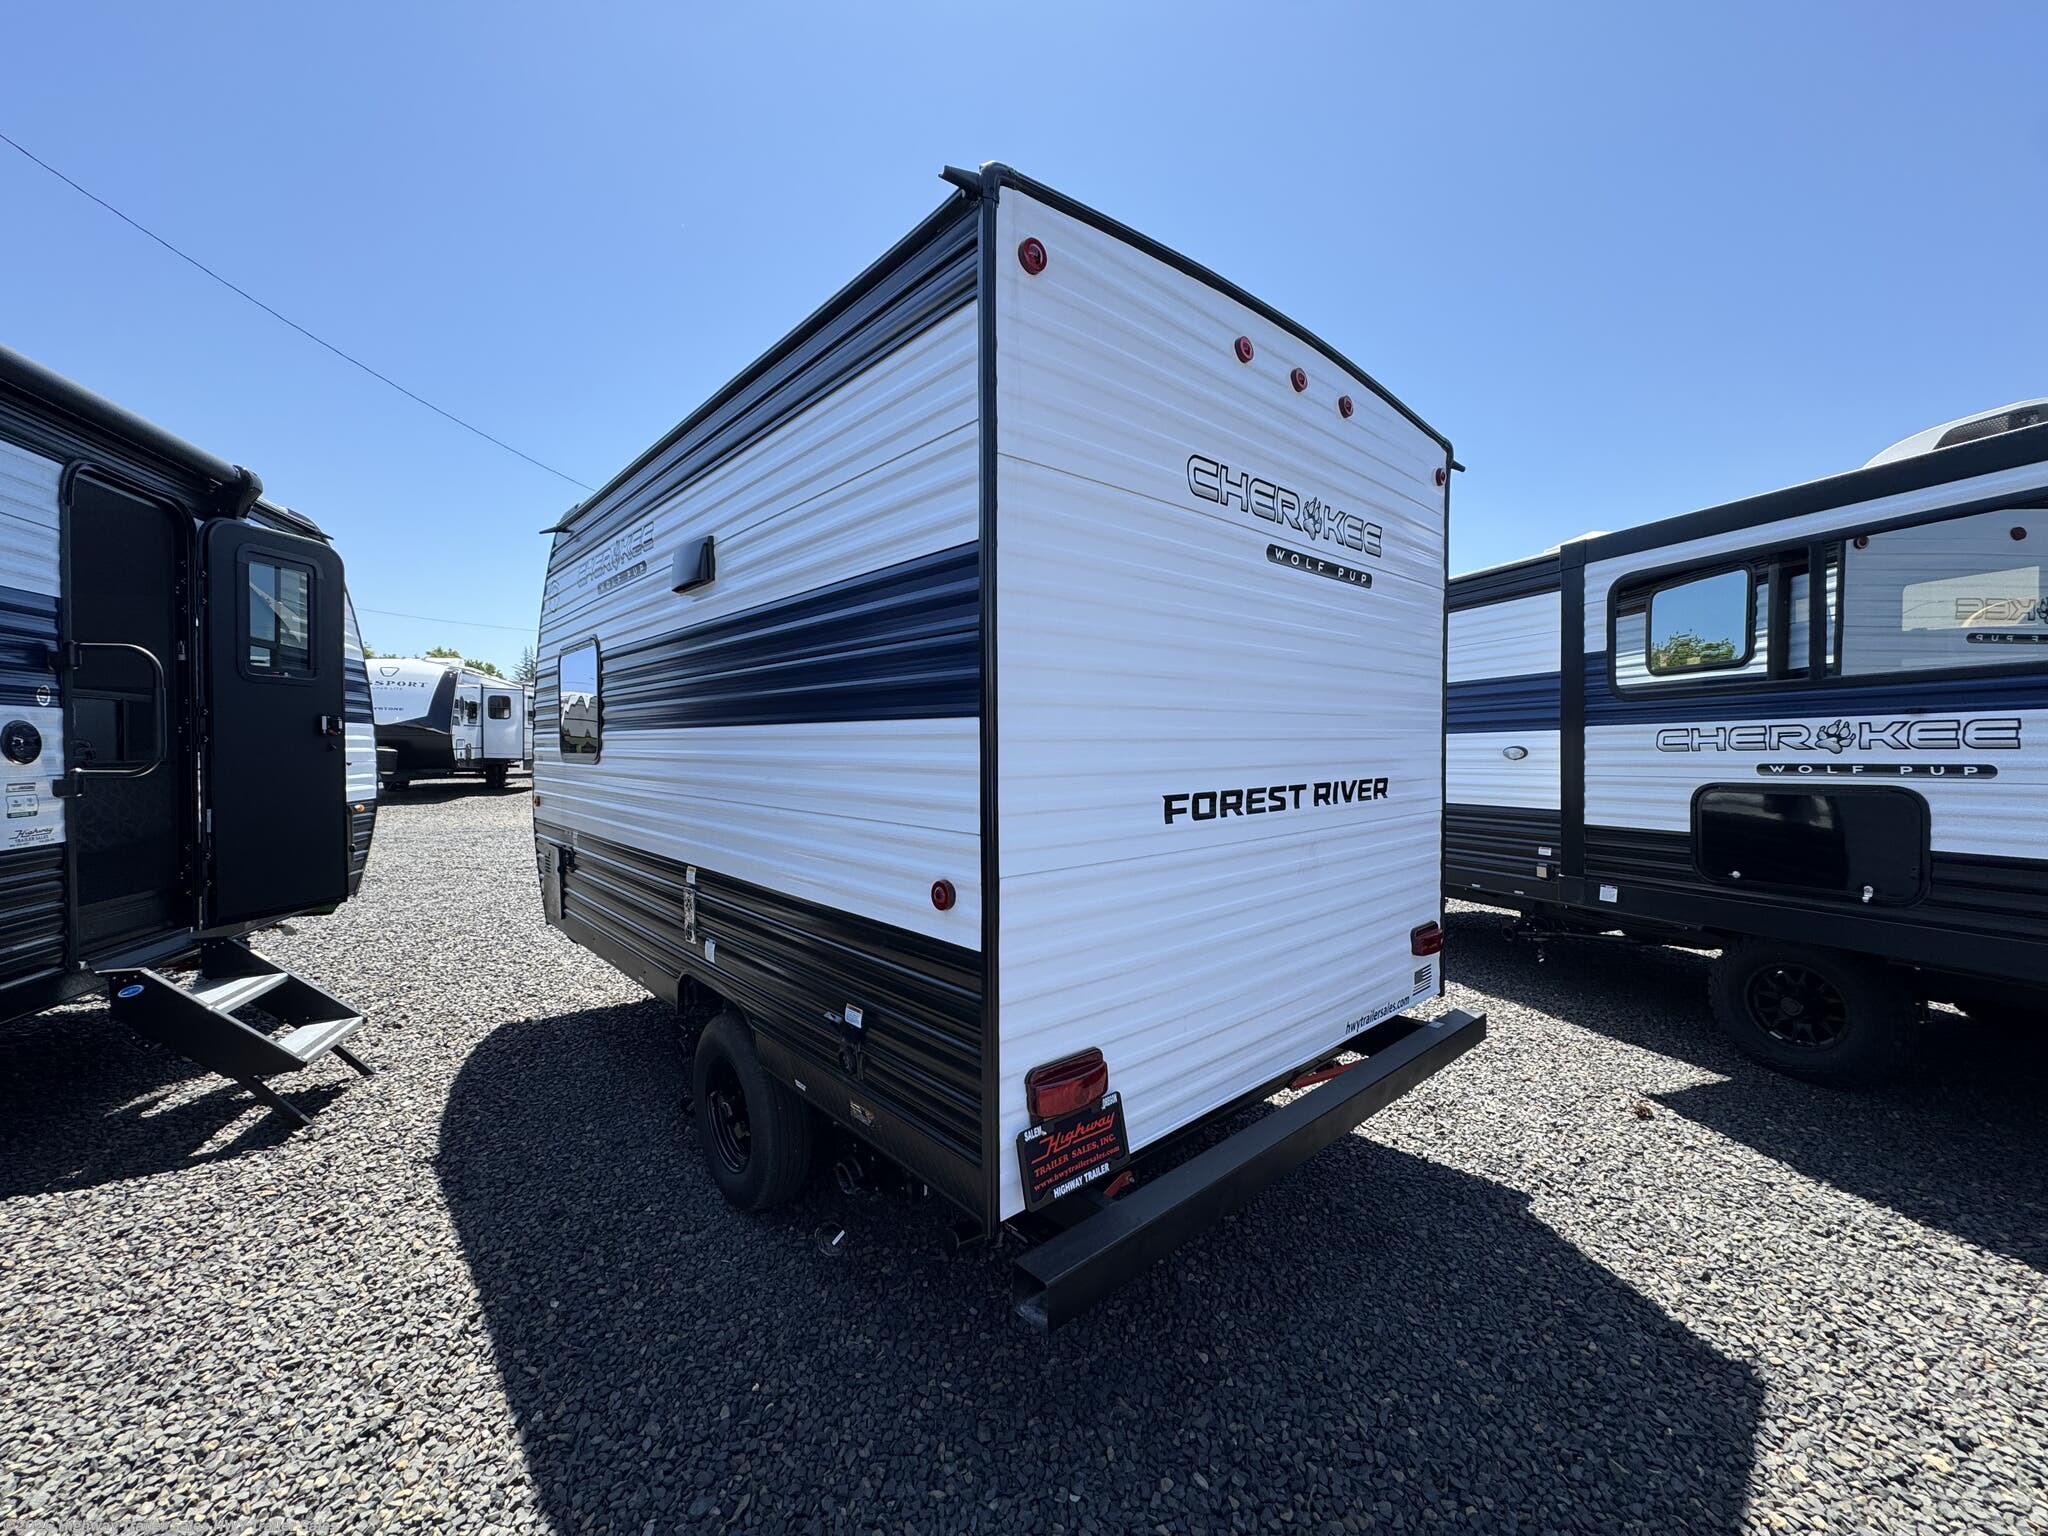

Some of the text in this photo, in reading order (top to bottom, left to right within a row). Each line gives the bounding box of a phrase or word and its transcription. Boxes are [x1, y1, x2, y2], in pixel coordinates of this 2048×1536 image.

[1274, 548, 1368, 584] WOLF PUP
[369, 680, 429, 688] SPORT
[1768, 764, 1979, 777] WOLF PUP
[1162, 777, 1389, 825] FOREST RIVER
[1345, 995, 1411, 1035] hwytrailersales.com
[1035, 1112, 1115, 1157] Highway
[1034, 1153, 1070, 1177] TRAILER
[1053, 1162, 1110, 1199] HIGHWAY TRAILER
